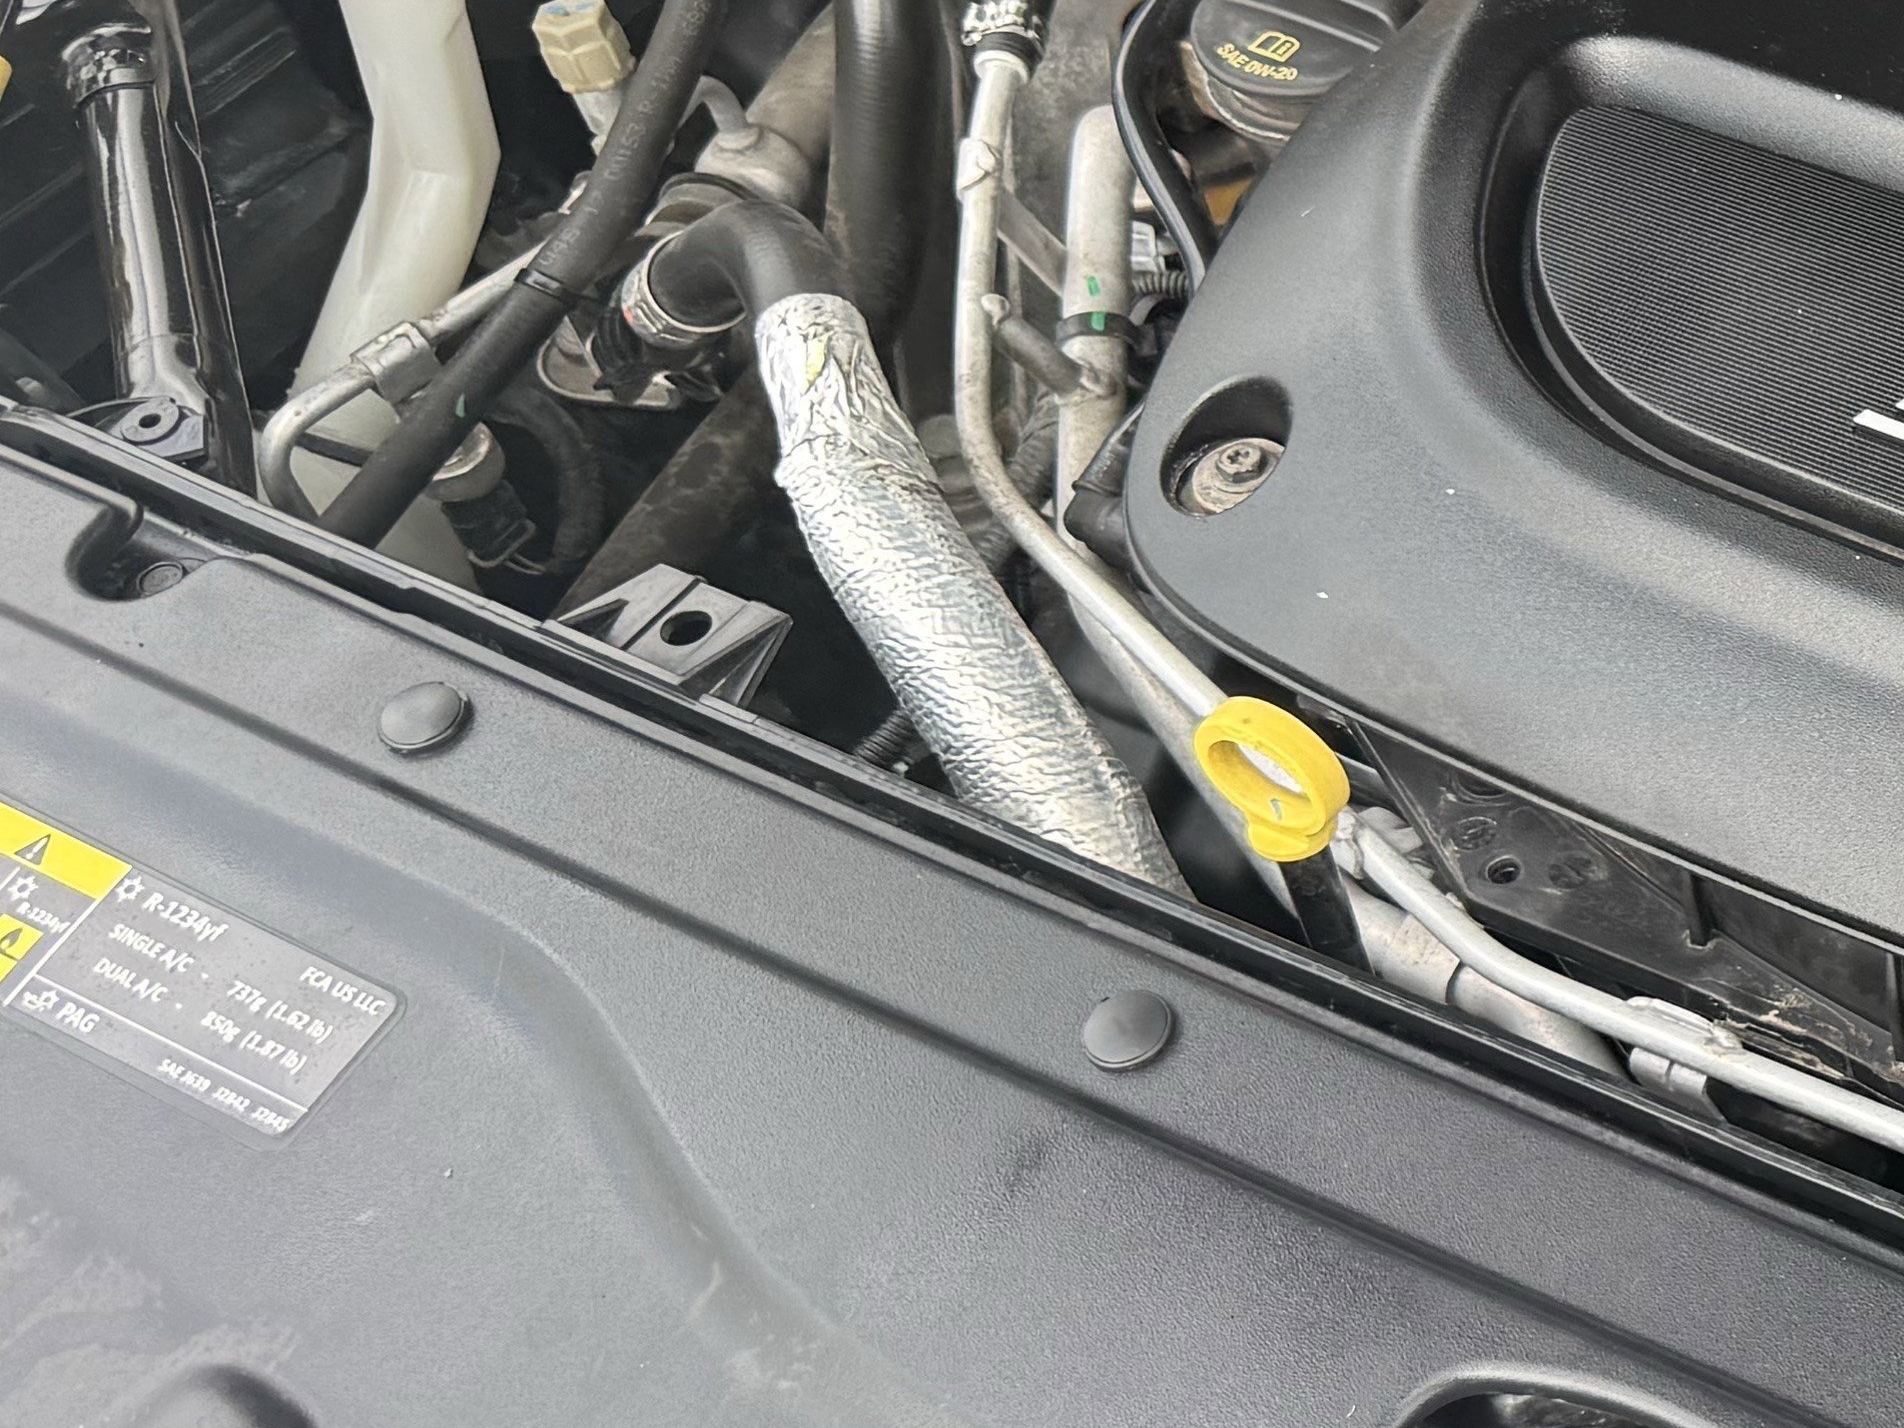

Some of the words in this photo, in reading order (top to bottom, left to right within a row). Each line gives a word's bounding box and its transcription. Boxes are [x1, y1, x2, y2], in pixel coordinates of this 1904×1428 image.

[1216, 42, 1246, 69] SAE
[1244, 60, 1300, 82] 0W-20
[142, 892, 229, 942] R-1234yf
[108, 923, 165, 959] SINGLE
[159, 949, 195, 973] A/C
[227, 980, 267, 1013] 737g
[265, 1000, 311, 1030] (1.62
[306, 1019, 334, 1045] lb)
[300, 966, 333, 992] FCA
[332, 980, 358, 1003] US
[354, 992, 386, 1016] LLC
[55, 1002, 100, 1033] PAG
[93, 957, 137, 988] DUAL
[132, 978, 168, 1003] A/C
[201, 1011, 241, 1044] 850g
[239, 1030, 286, 1060] (1.87
[280, 1049, 308, 1075] lb)
[157, 1059, 186, 1080] SAE
